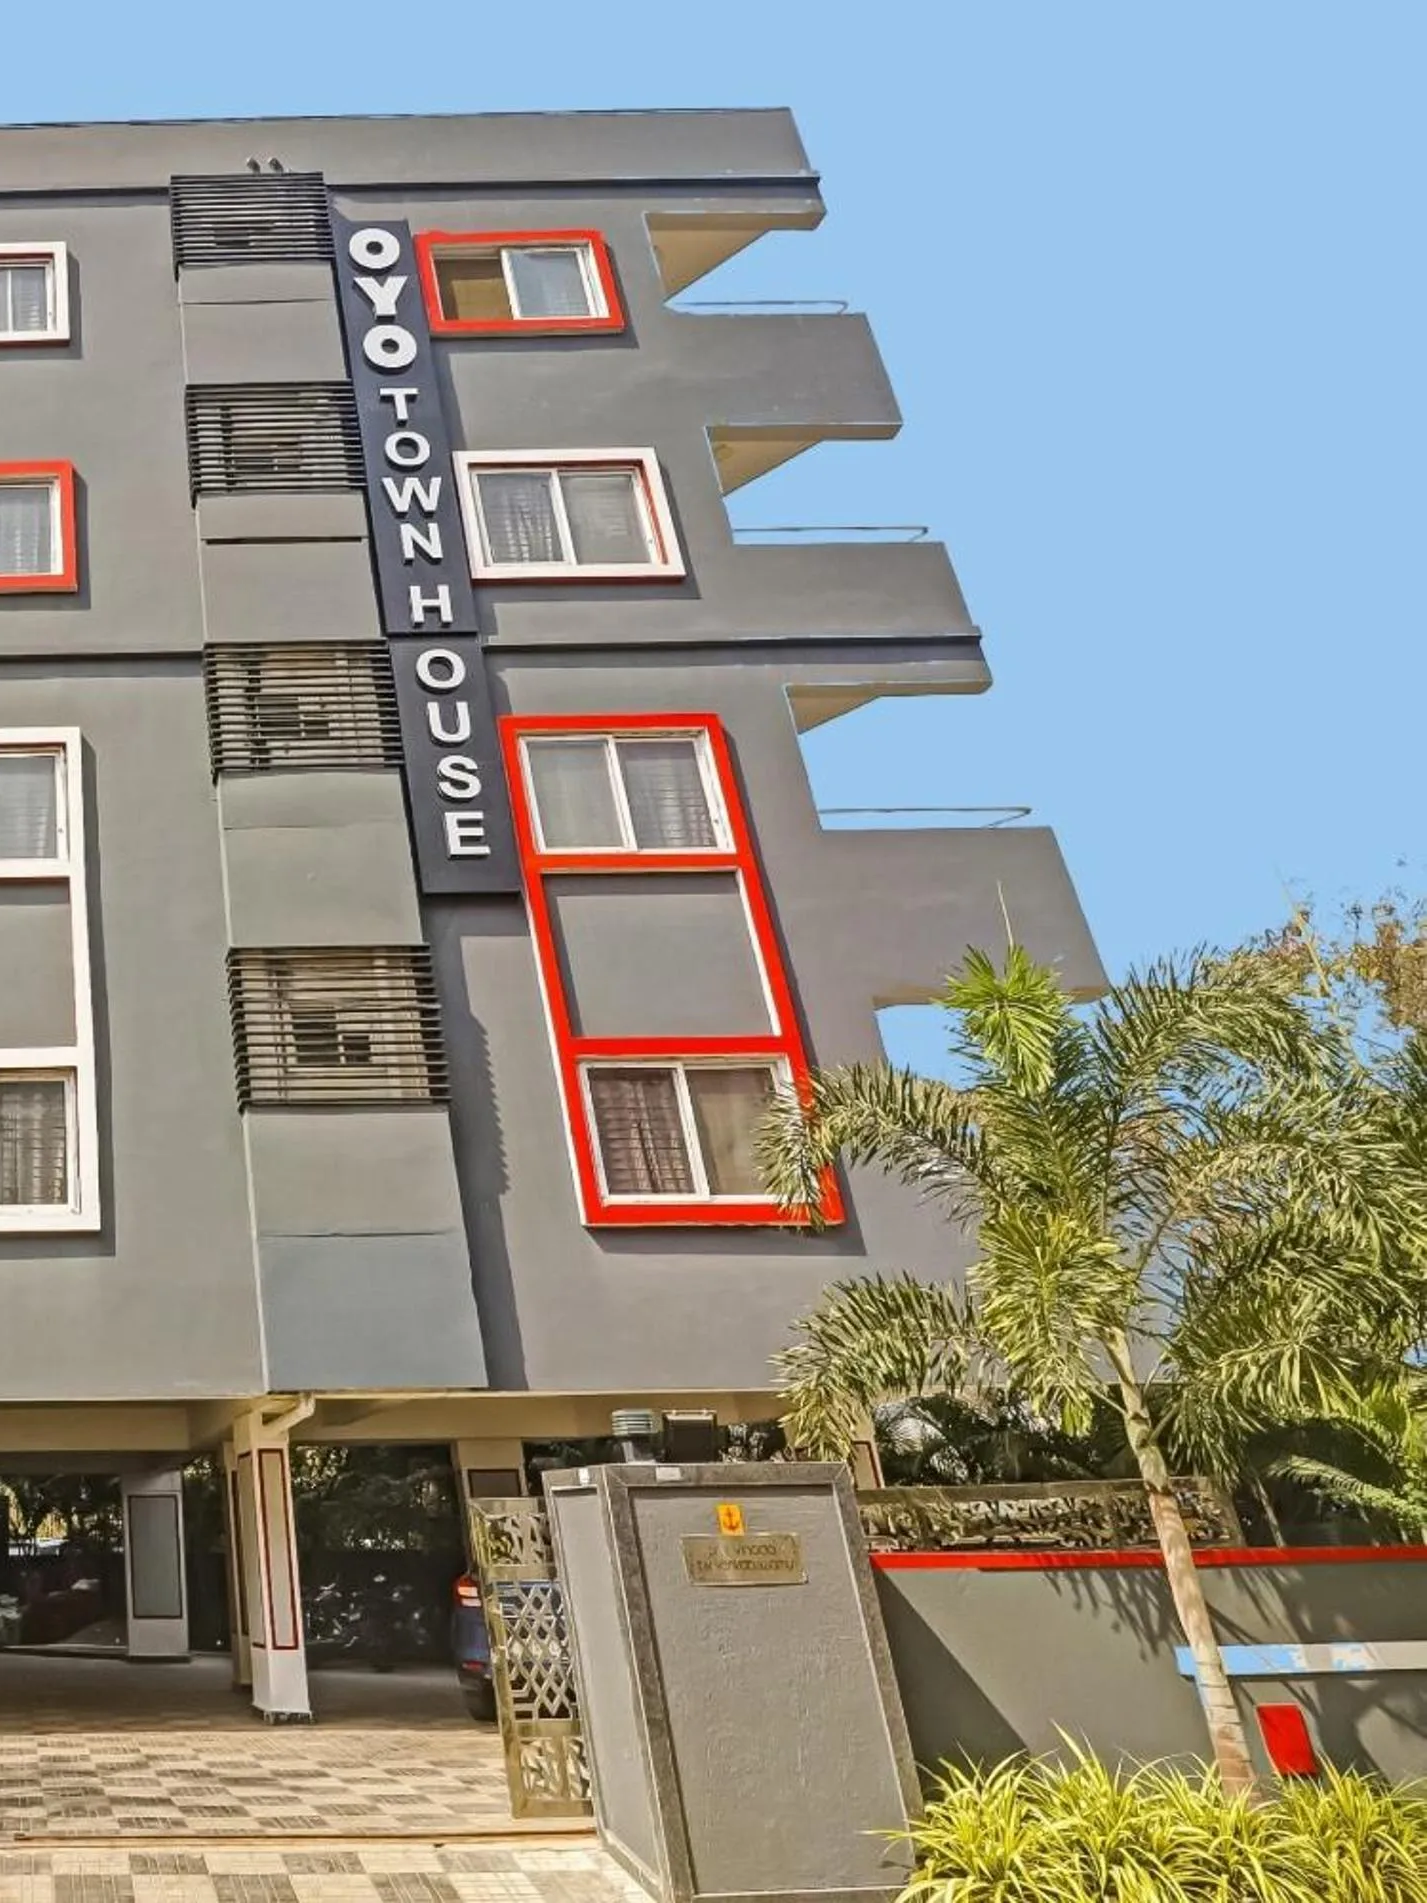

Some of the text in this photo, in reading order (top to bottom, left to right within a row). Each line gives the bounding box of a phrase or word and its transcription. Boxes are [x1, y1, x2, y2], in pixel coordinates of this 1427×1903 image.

[349, 228, 491, 856] OYO TOWN HOUSE
